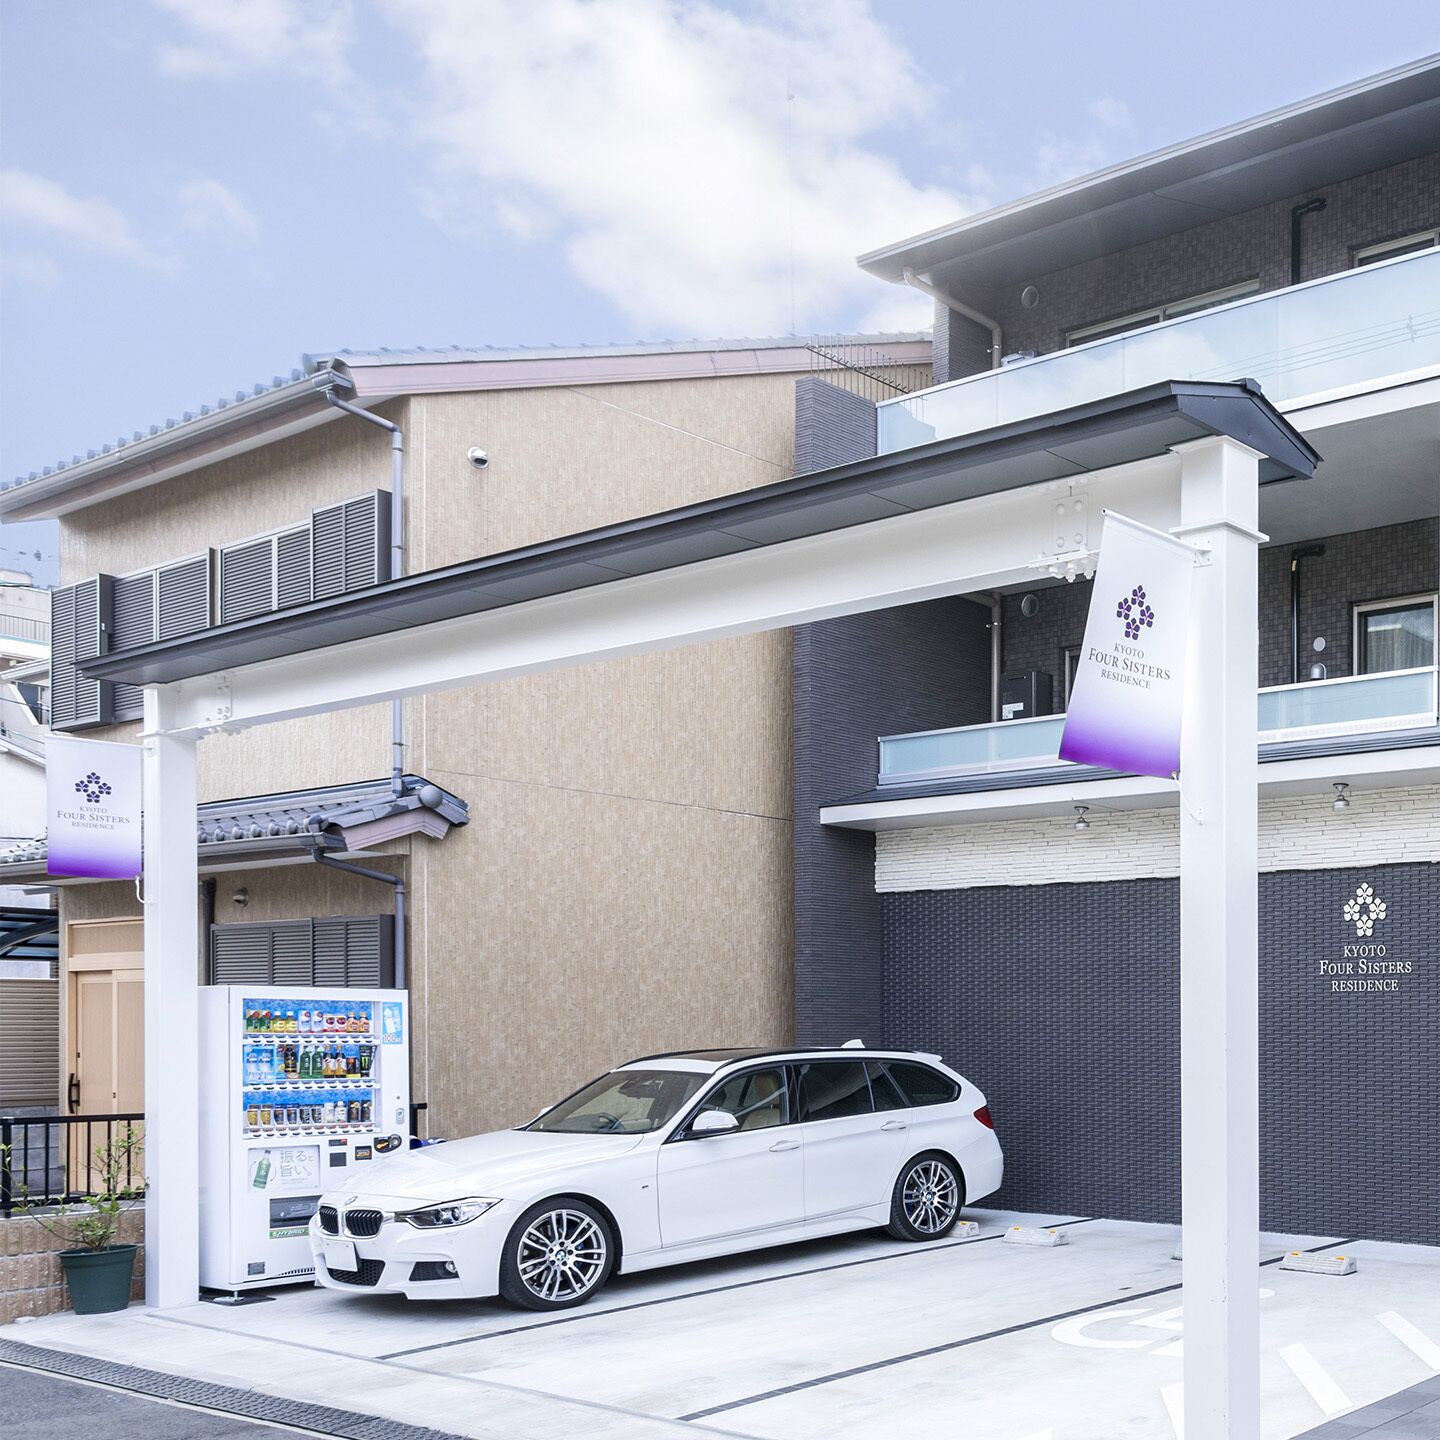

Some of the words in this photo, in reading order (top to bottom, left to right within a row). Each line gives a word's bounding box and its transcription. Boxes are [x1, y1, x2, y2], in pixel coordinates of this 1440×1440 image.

[1114, 643, 1145, 659] KYOTO
[1088, 647, 1119, 668] FOUR
[1122, 657, 1171, 681] SISTERS
[1101, 668, 1151, 690] RESIDENCE
[57, 810, 86, 821] FOUR
[89, 812, 130, 824] SISTERS
[79, 806, 108, 814] KYOTO
[71, 821, 115, 830] RESIDENCE
[1343, 944, 1387, 957] KYOTO
[1319, 960, 1354, 975] FOUR
[1358, 958, 1413, 975] SISTERS
[1331, 979, 1399, 992] RESIDENCE
